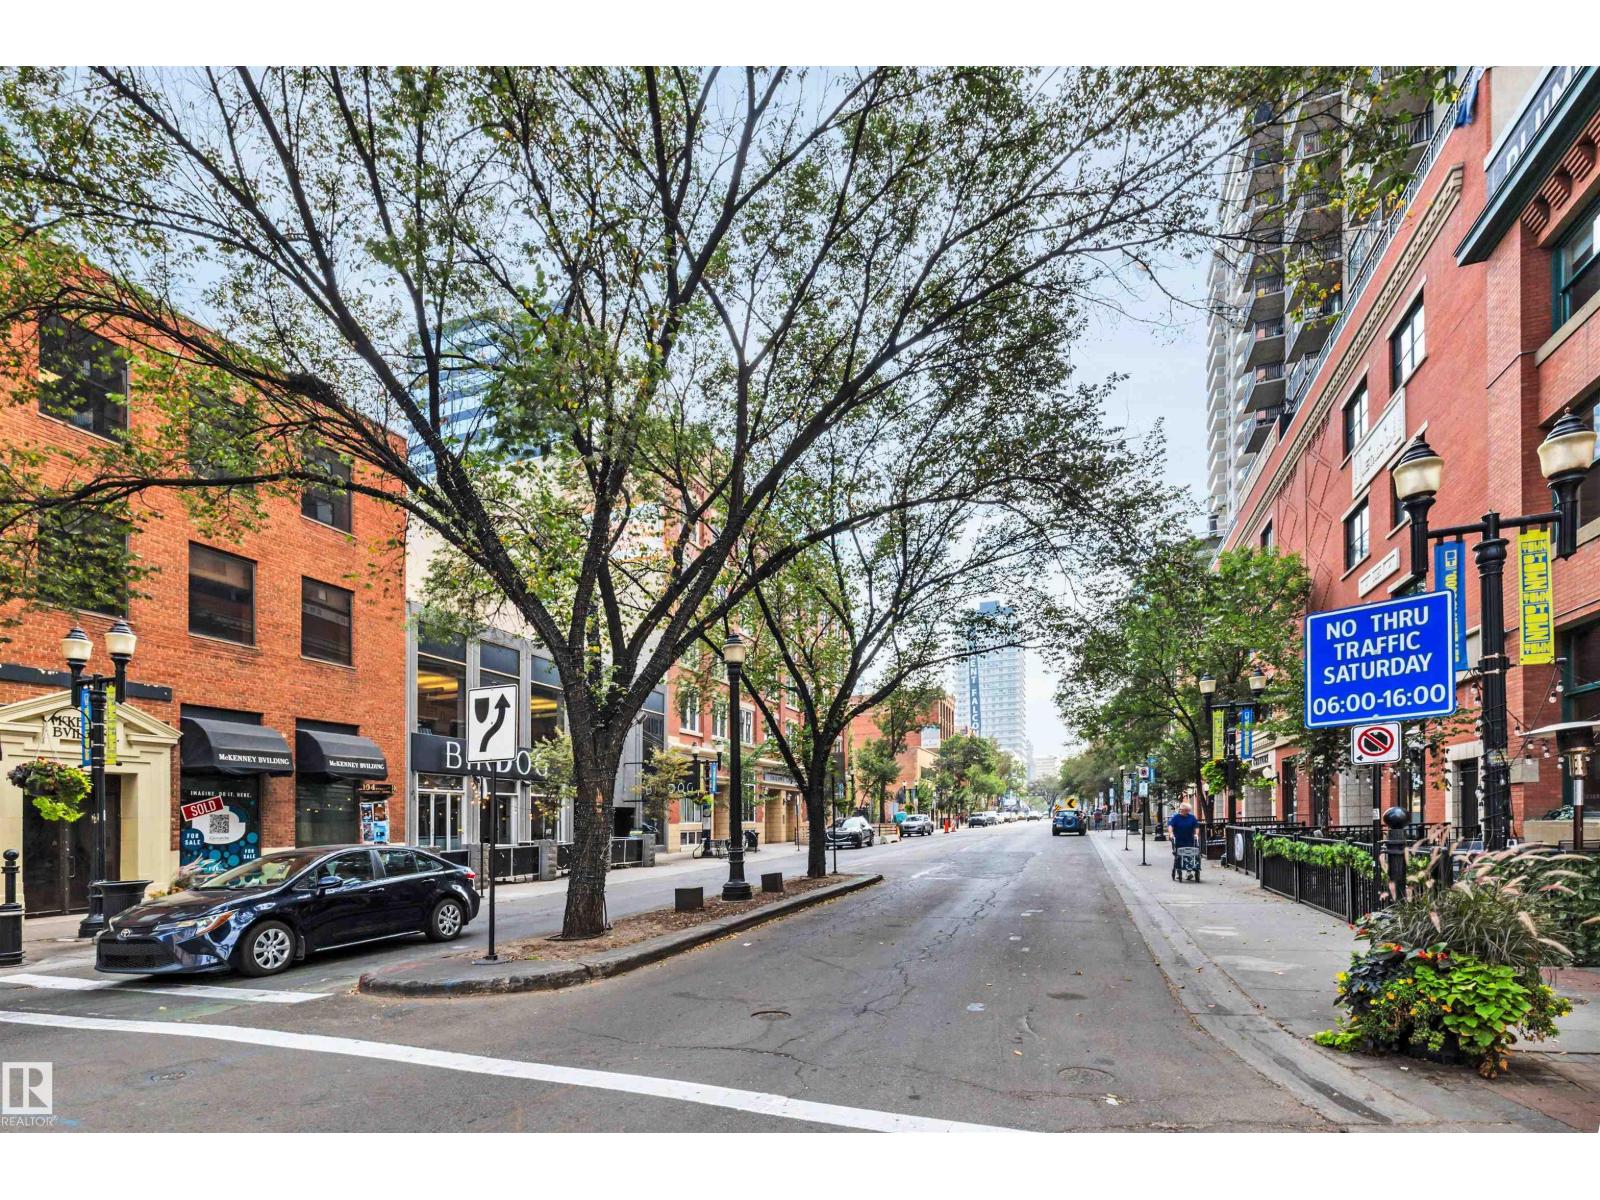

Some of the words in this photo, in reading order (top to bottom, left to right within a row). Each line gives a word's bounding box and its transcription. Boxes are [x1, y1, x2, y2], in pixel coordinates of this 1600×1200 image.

[1326, 619, 1357, 640] NO
[1370, 605, 1429, 632] THRU
[1334, 631, 1421, 661] TRAFFIC
[1323, 652, 1432, 685] SATURDAY
[1313, 683, 1446, 715] 06:00-16:00
[190, 800, 217, 817] SOLD
